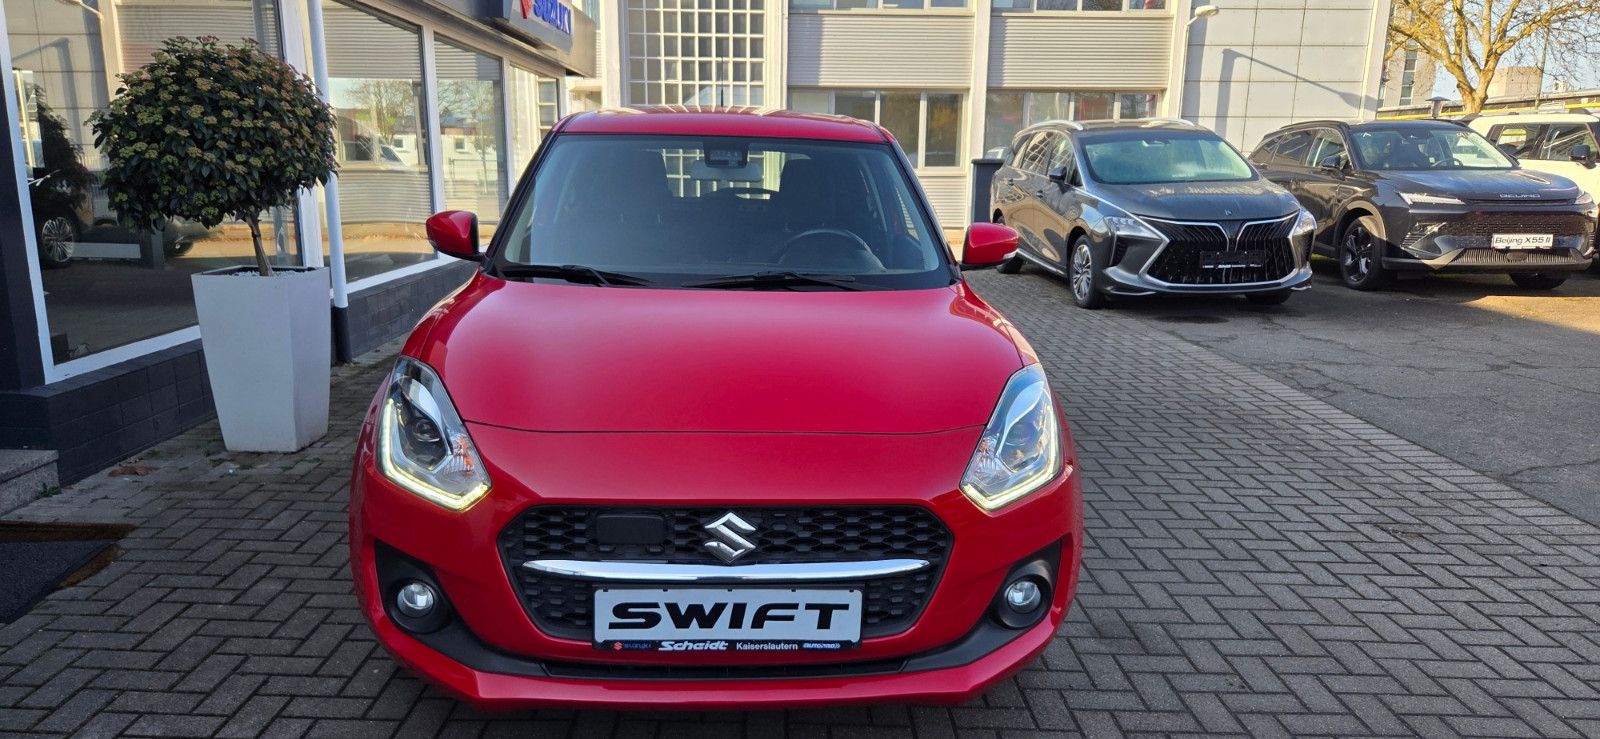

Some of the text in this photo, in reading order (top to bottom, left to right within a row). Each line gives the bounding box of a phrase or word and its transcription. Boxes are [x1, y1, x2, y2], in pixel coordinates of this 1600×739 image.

[1495, 236, 1523, 246] Beijing
[608, 602, 850, 630] SWIFT
[736, 642, 799, 651] Kaiserslautern
